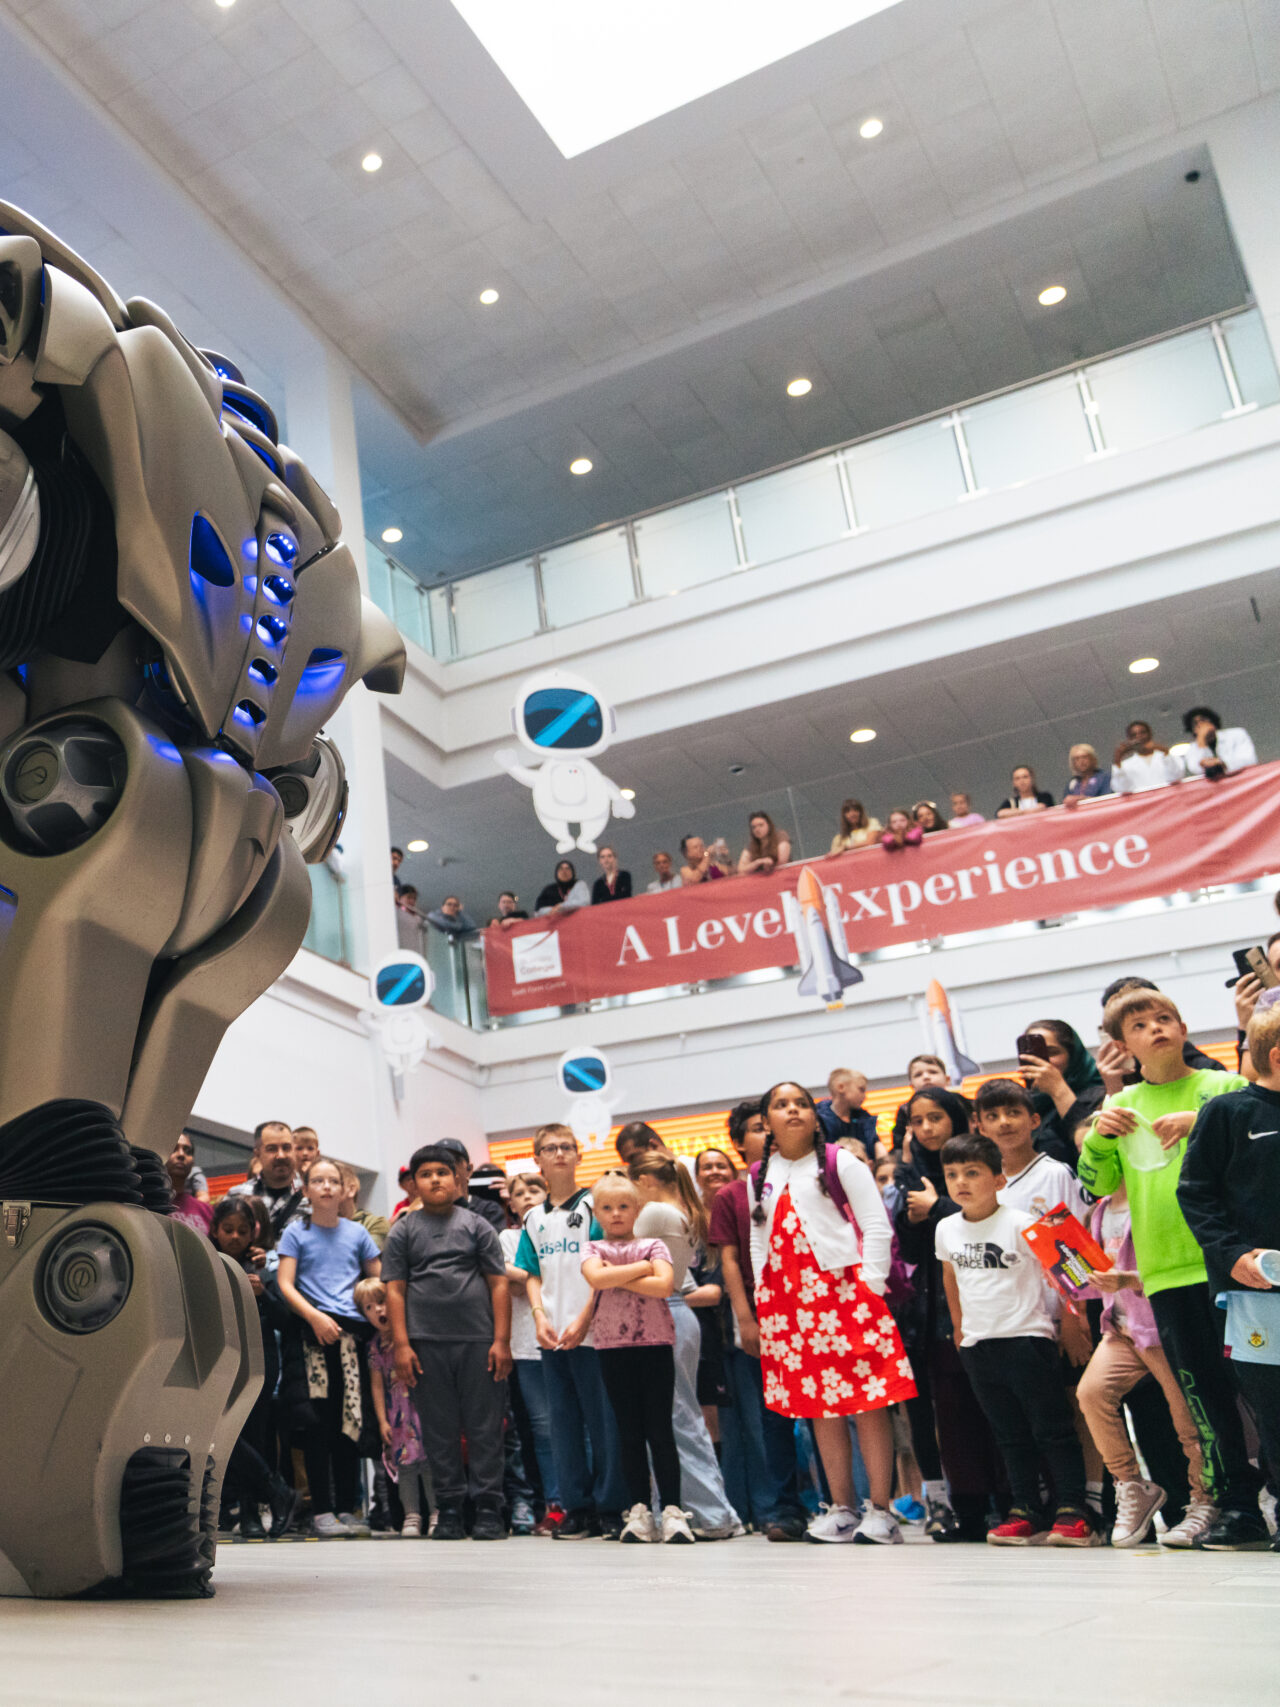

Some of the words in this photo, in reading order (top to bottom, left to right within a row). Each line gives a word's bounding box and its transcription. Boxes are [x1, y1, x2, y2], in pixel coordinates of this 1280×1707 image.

[616, 924, 652, 966] A
[662, 890, 795, 957] Level
[963, 1243, 983, 1252] THE
[958, 1259, 984, 1269] FACE
